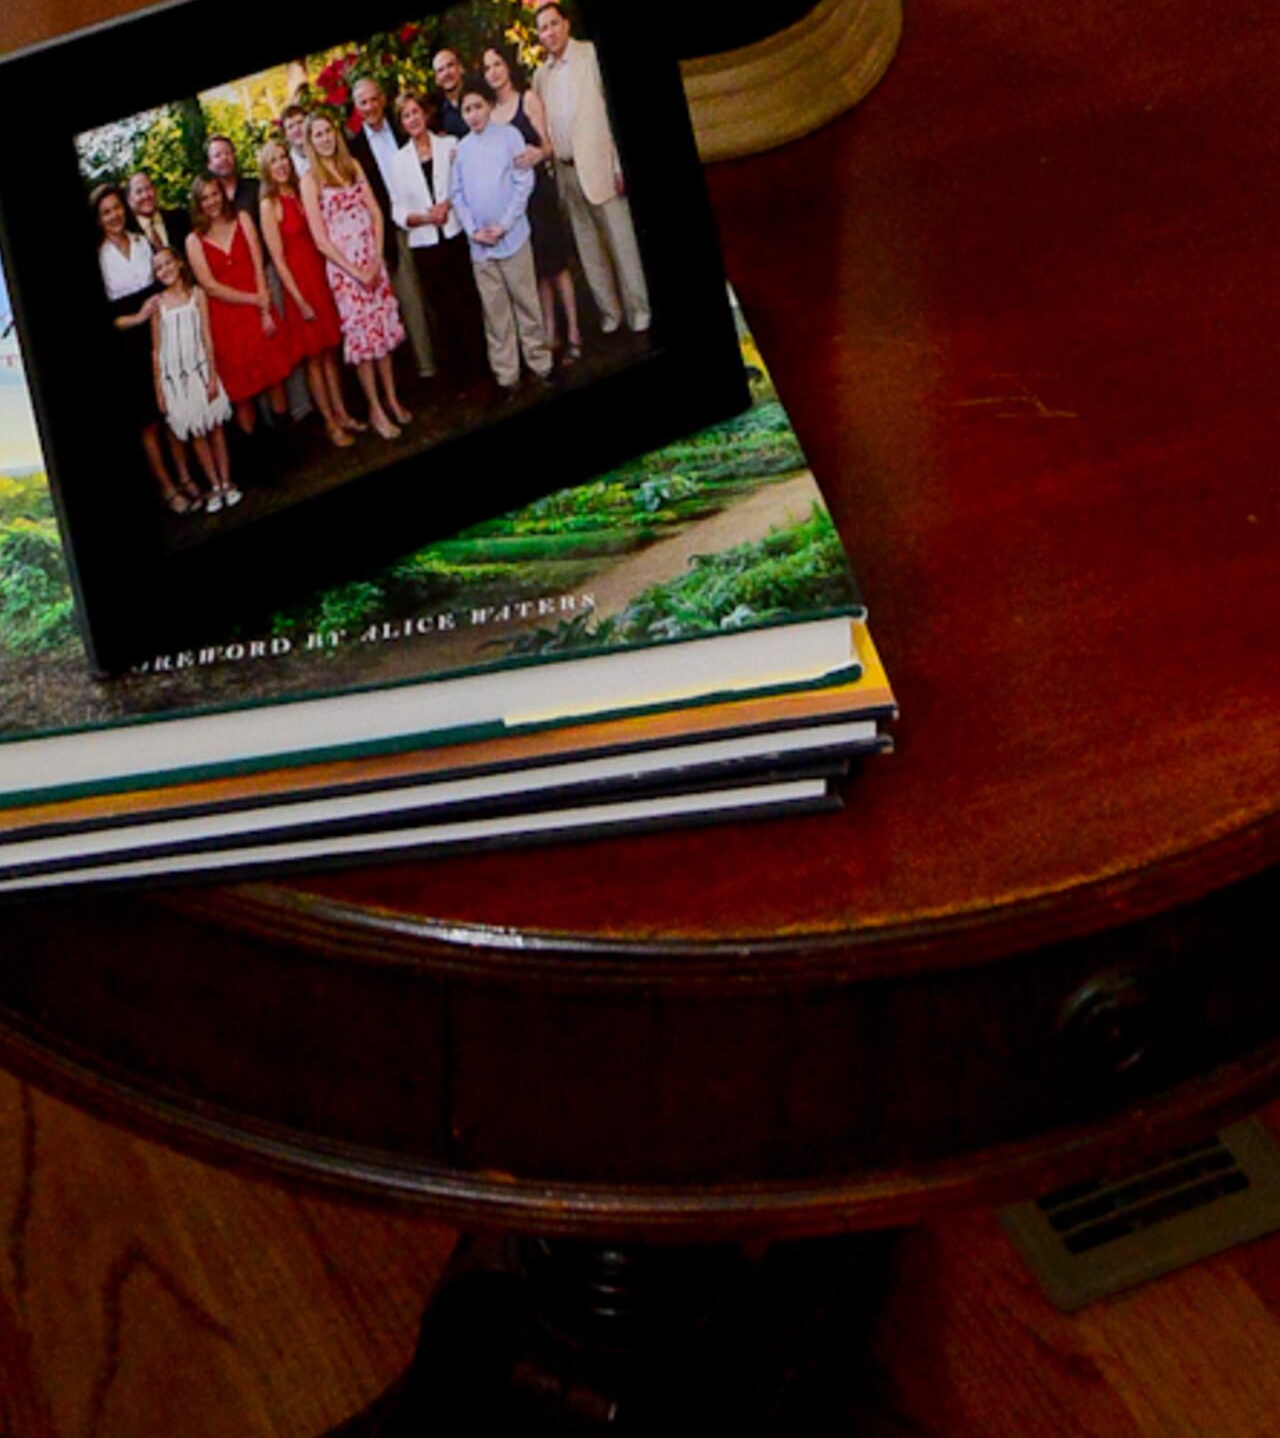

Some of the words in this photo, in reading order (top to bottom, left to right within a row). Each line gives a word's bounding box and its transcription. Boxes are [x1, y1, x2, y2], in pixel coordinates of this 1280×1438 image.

[306, 630, 348, 651] BY
[360, 611, 456, 643] ALICE
[471, 590, 597, 625] WATERS
